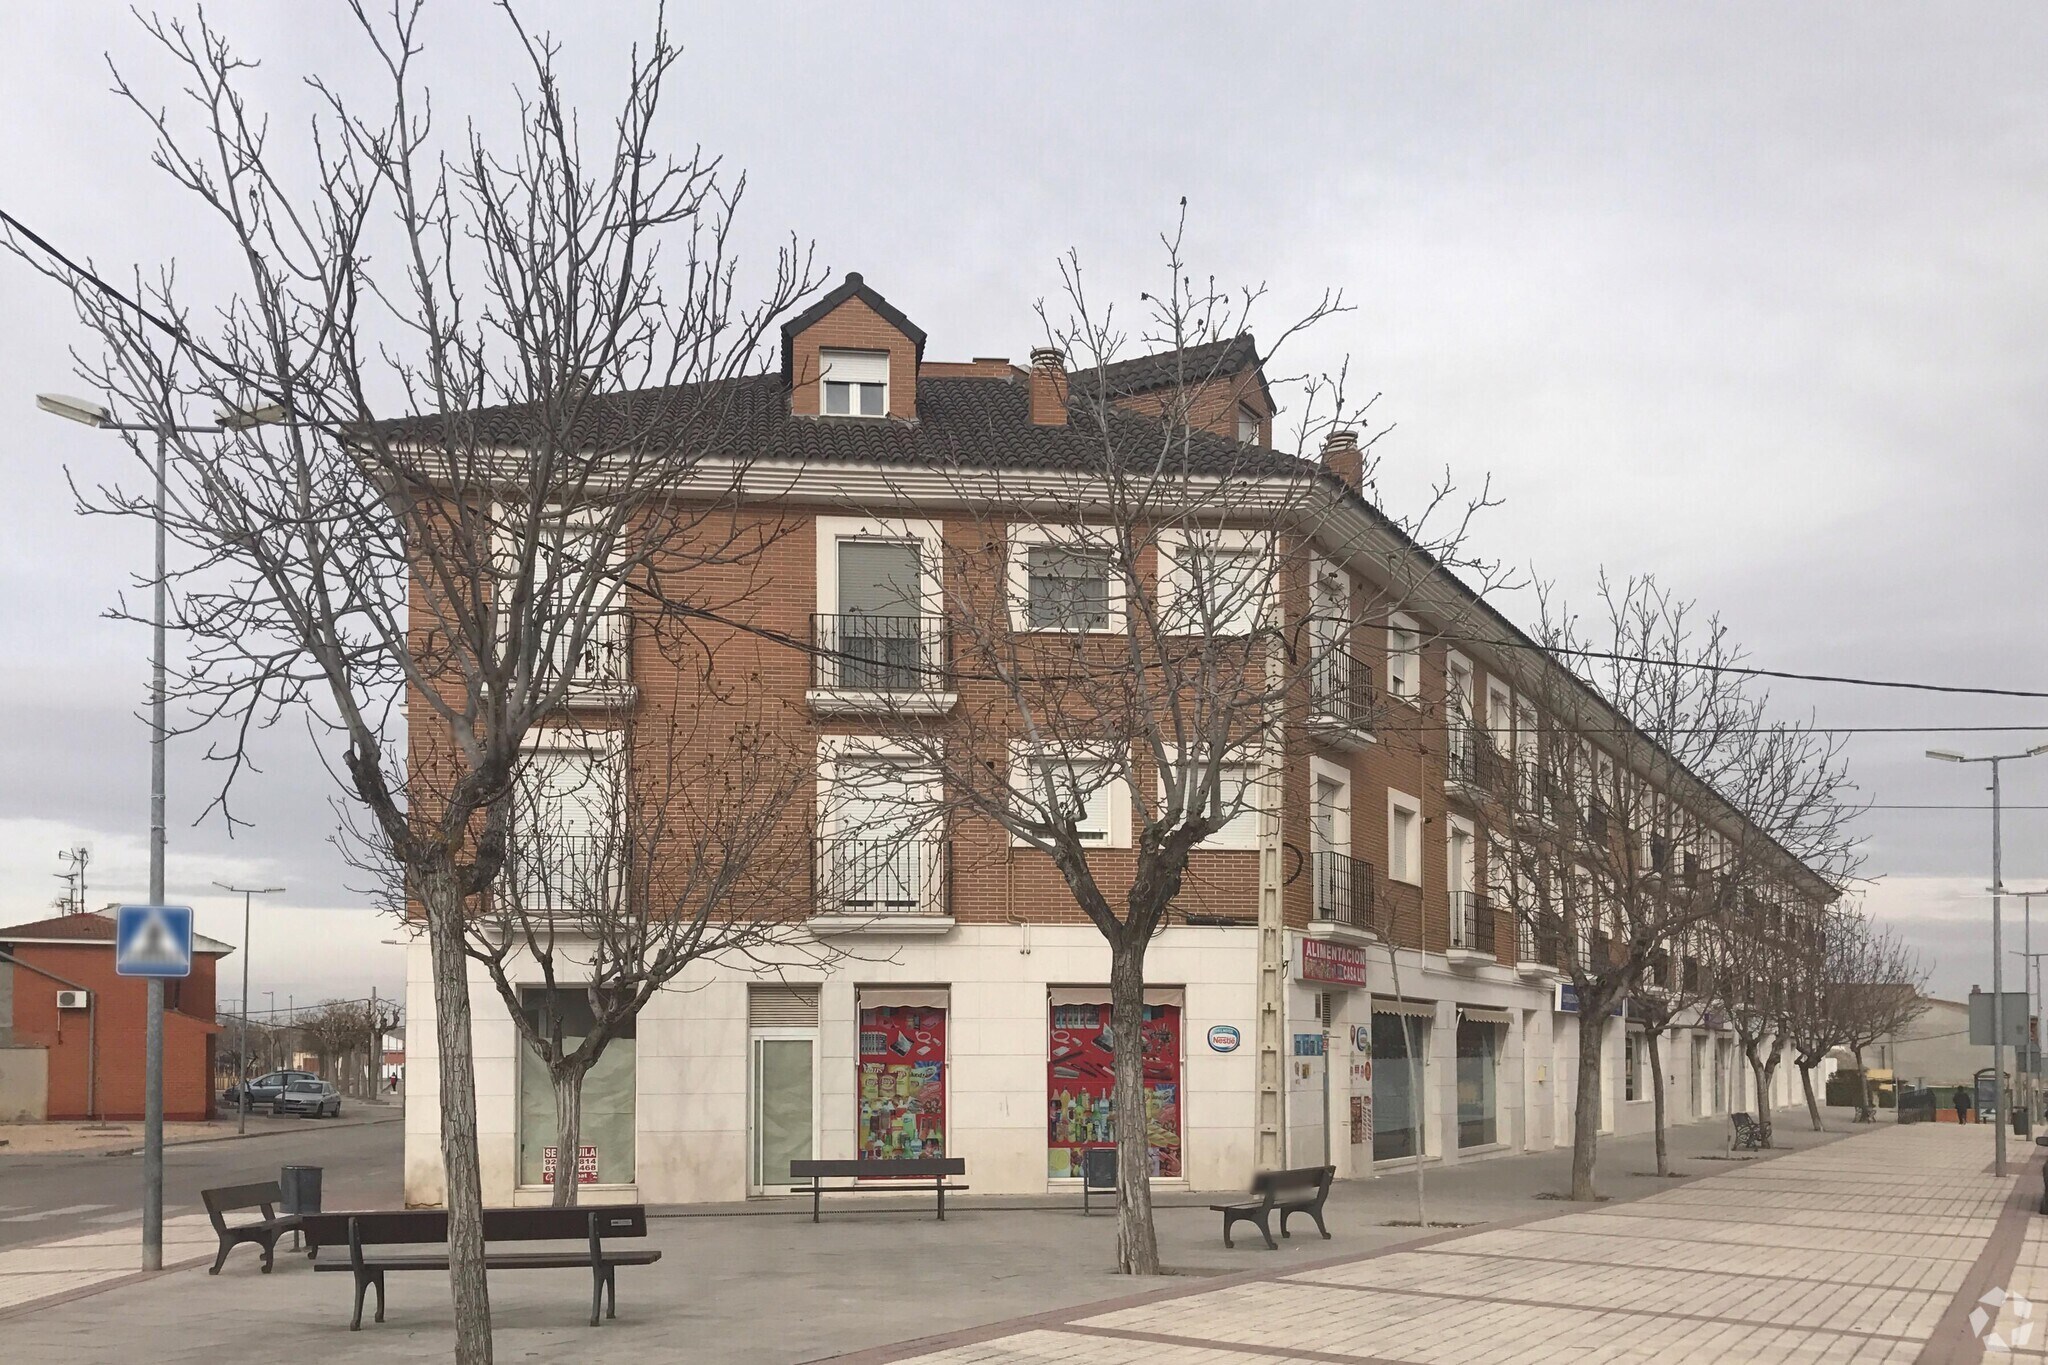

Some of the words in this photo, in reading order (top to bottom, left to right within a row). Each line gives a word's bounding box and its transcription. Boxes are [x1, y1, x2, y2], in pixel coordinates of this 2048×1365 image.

[1306, 941, 1365, 965] ALIMENTACION
[1343, 965, 1357, 981] CASA
[545, 1148, 557, 1158] SE
